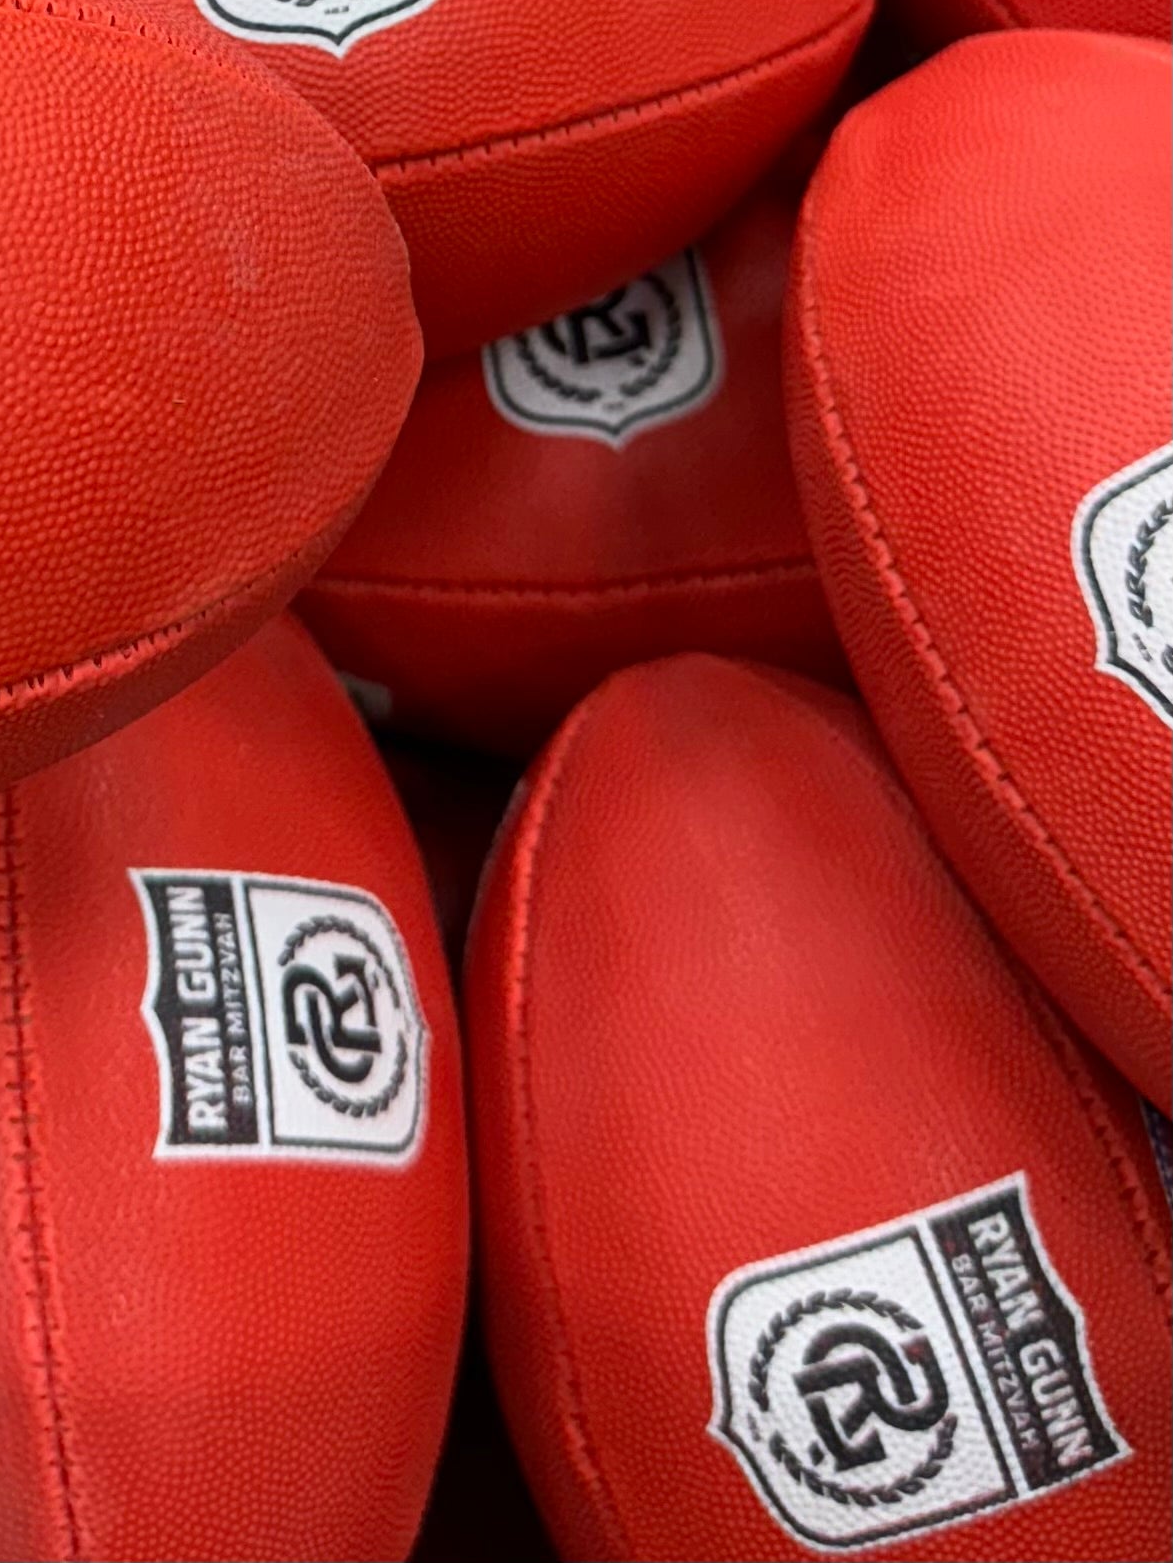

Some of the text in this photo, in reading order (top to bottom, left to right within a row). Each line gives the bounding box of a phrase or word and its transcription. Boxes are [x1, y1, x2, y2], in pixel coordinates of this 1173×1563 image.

[166, 885, 228, 1135] RYAN GUNN
[213, 912, 254, 1105] BAR MITZVAH
[951, 1252, 1044, 1450] BAR MITZVAH
[968, 1211, 1095, 1470] RYAN GUNN
